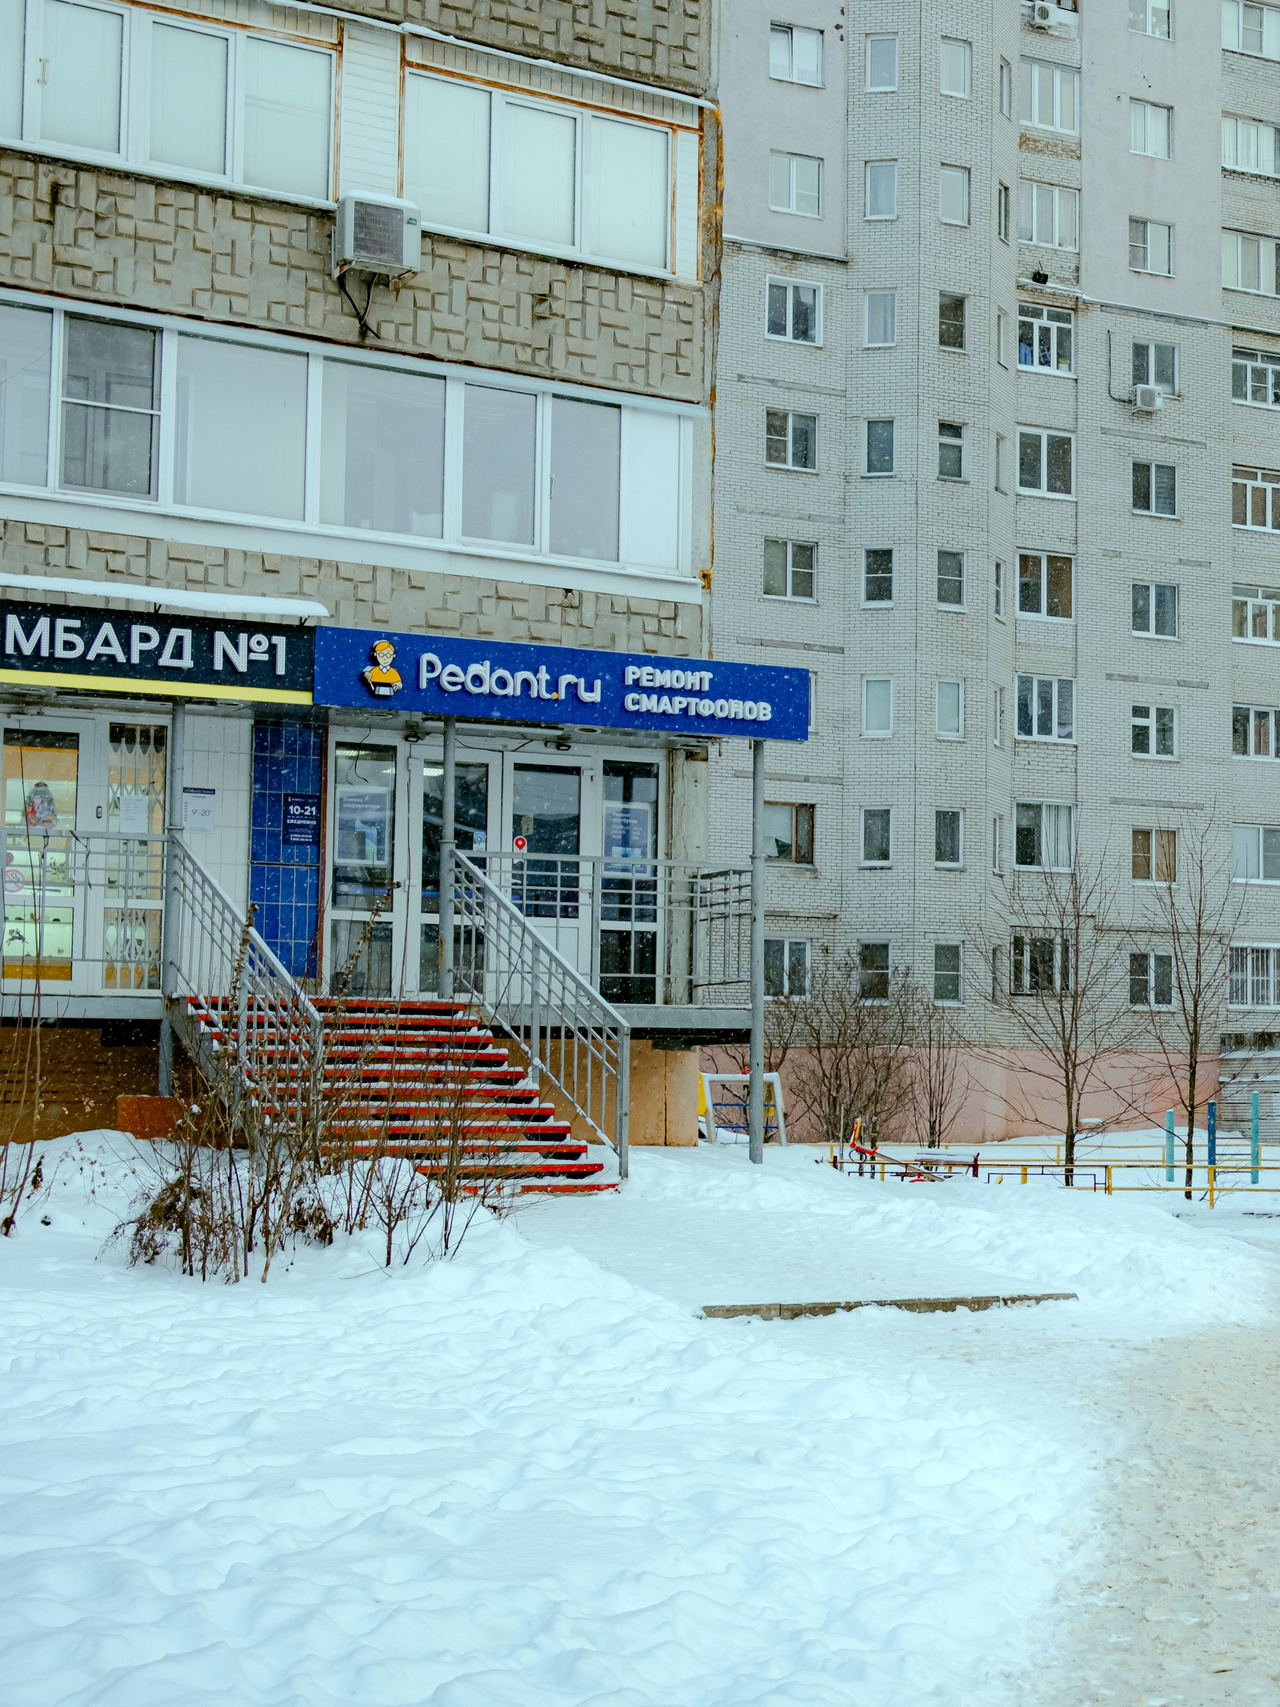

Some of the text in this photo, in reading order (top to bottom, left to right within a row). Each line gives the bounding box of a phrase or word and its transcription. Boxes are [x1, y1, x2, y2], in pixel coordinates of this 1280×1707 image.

[4, 613, 286, 676] МБАРД №1
[419, 652, 602, 703] Pedant.ru
[624, 665, 713, 692] РЕМОНТ
[624, 692, 772, 721] СМАРТФОНОВ
[288, 805, 316, 816] 10-21
